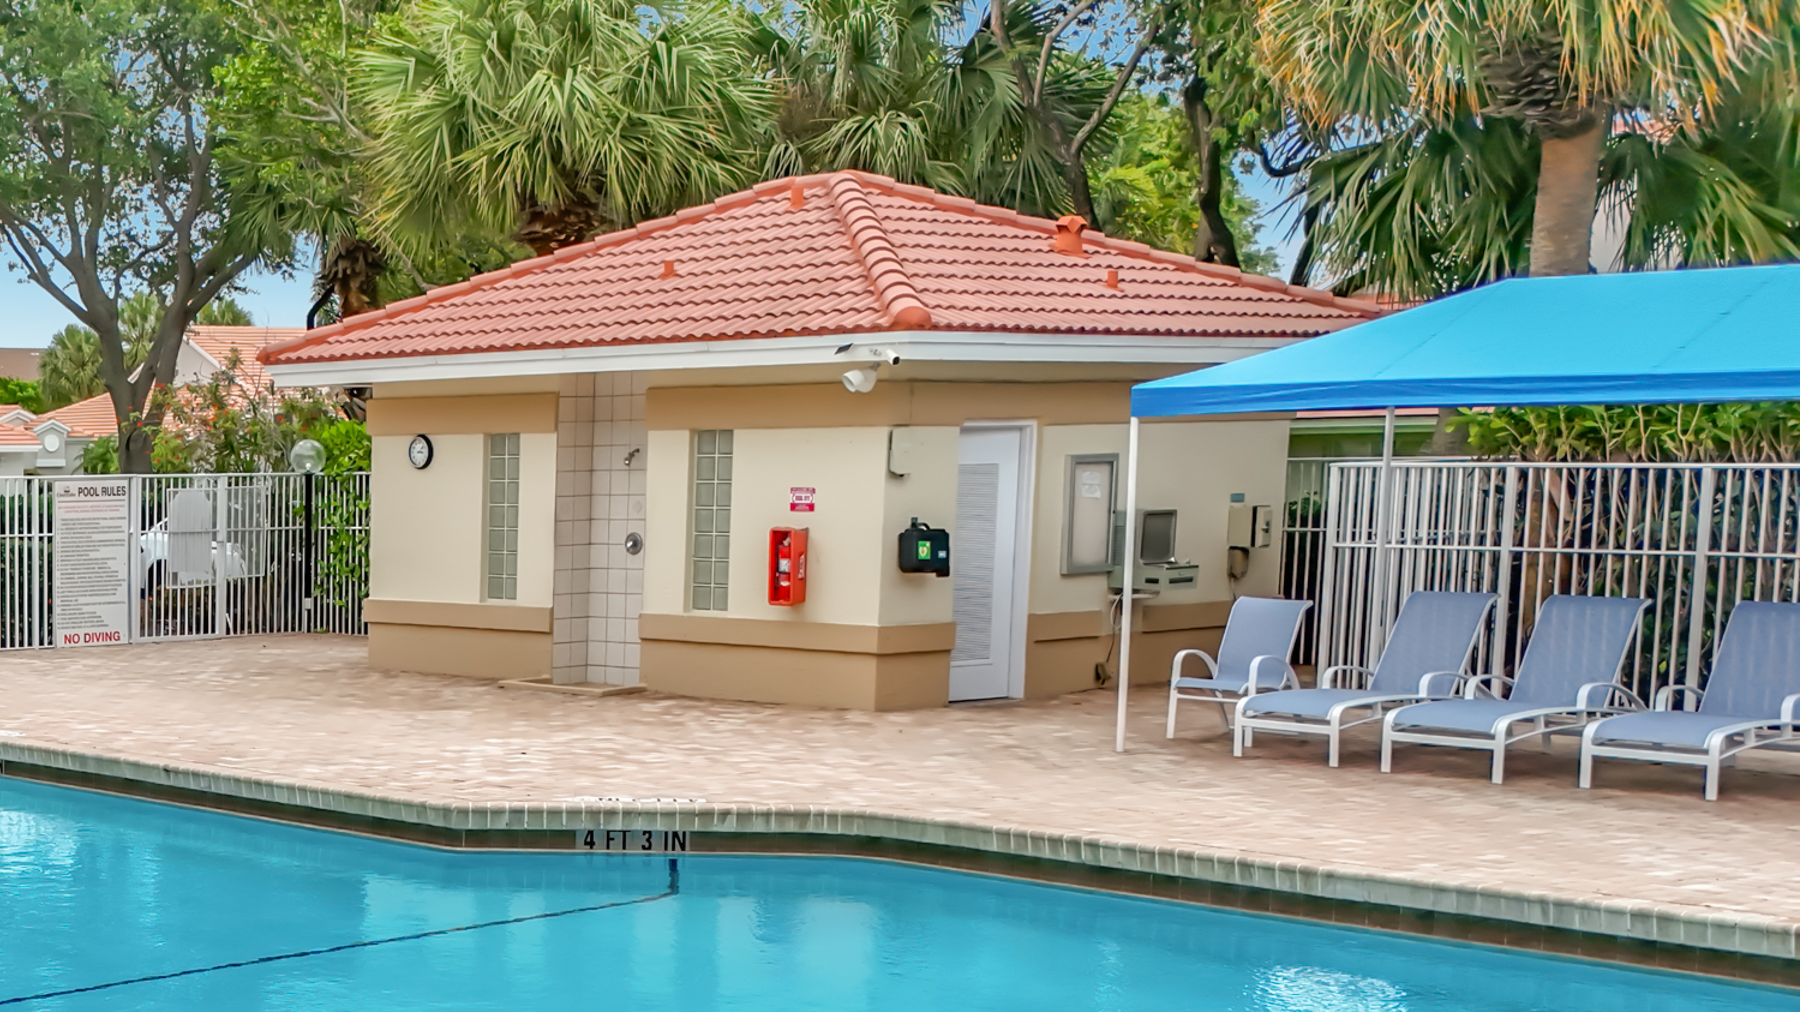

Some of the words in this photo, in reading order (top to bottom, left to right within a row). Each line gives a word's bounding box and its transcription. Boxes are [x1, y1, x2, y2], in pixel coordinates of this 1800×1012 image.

[78, 486, 99, 497] POOL
[101, 485, 126, 497] RULES
[64, 634, 80, 644] NO
[84, 630, 121, 643] DIVING
[584, 830, 596, 849] 4
[606, 830, 631, 850] FT
[641, 830, 652, 850] 3
[664, 831, 686, 851] IN
